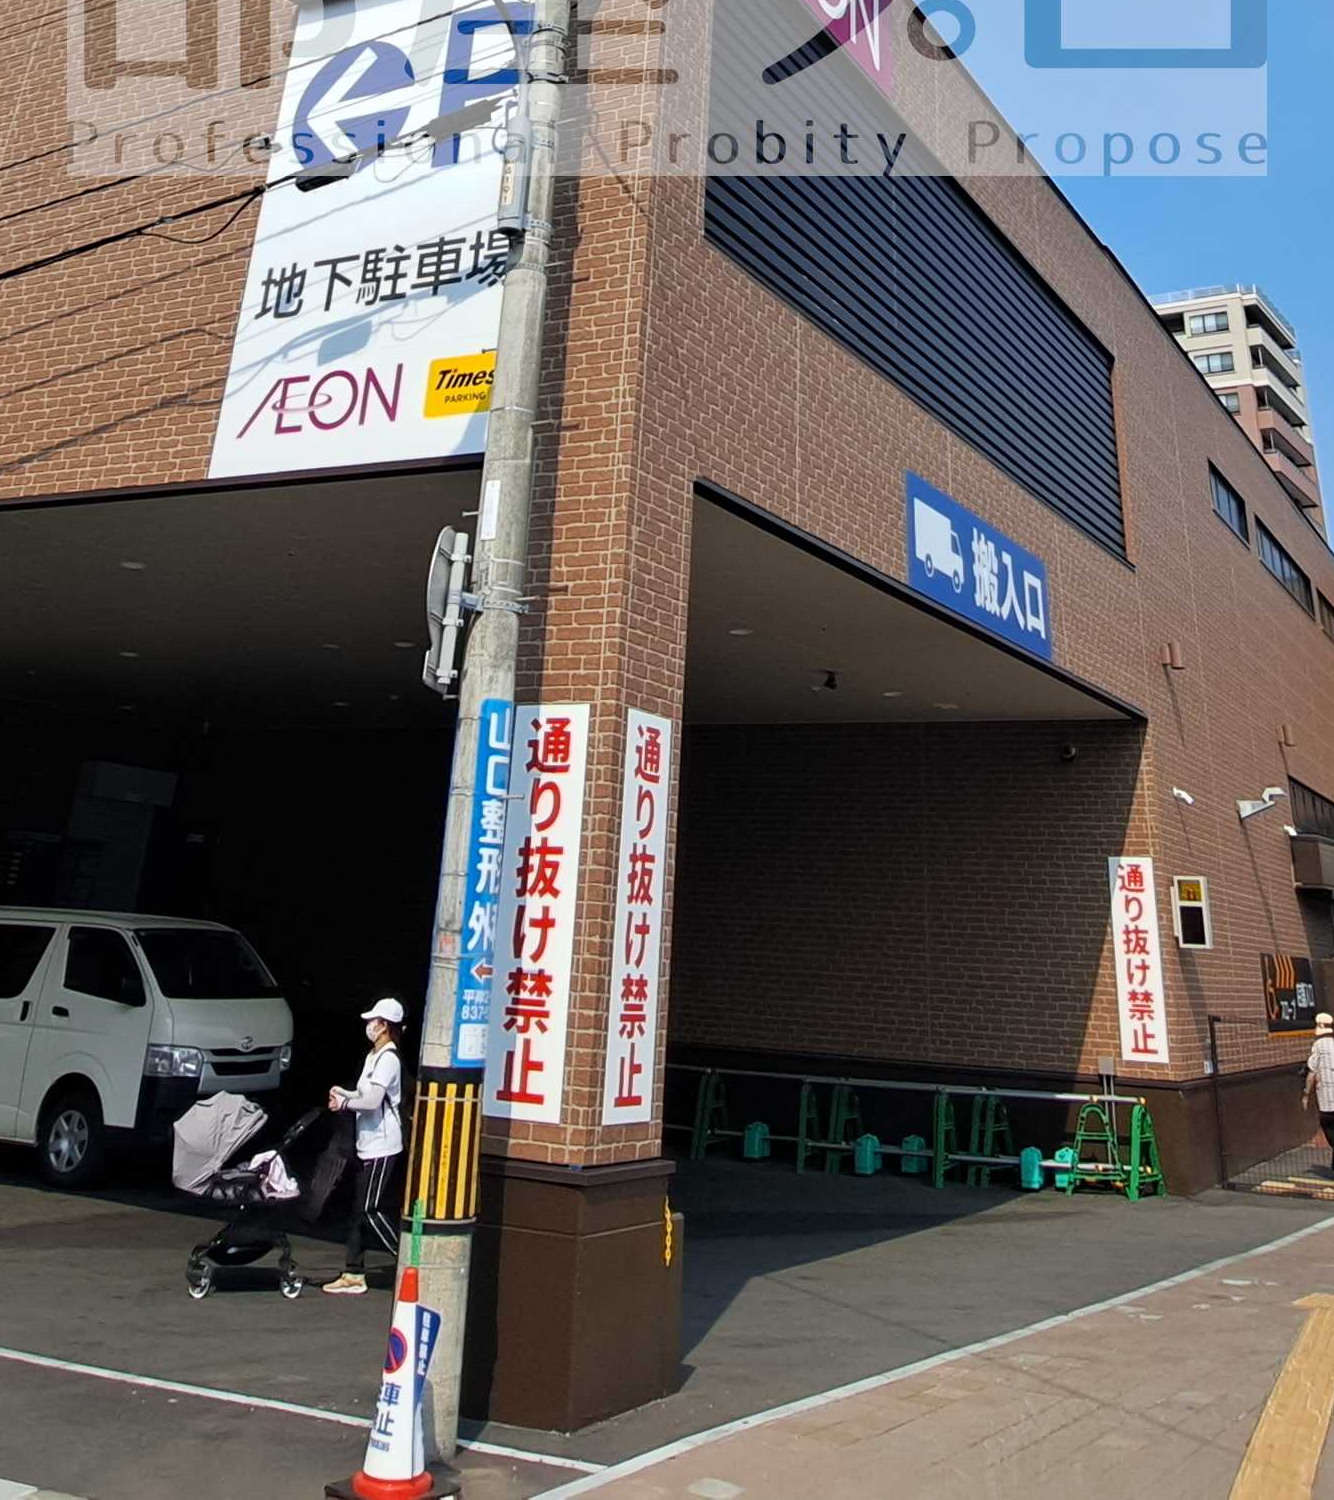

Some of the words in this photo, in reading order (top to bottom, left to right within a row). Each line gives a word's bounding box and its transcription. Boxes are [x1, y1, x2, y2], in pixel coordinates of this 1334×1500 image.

[254, 231, 510, 320] 地下駐車場
[434, 365, 494, 391] Times
[444, 392, 486, 404] PARKING
[971, 527, 1046, 640] 搬入口
[497, 717, 571, 1106] 通り抜け禁止
[613, 725, 663, 1107] 通り抜け禁止
[1117, 863, 1159, 1055] 通り抜け禁止
